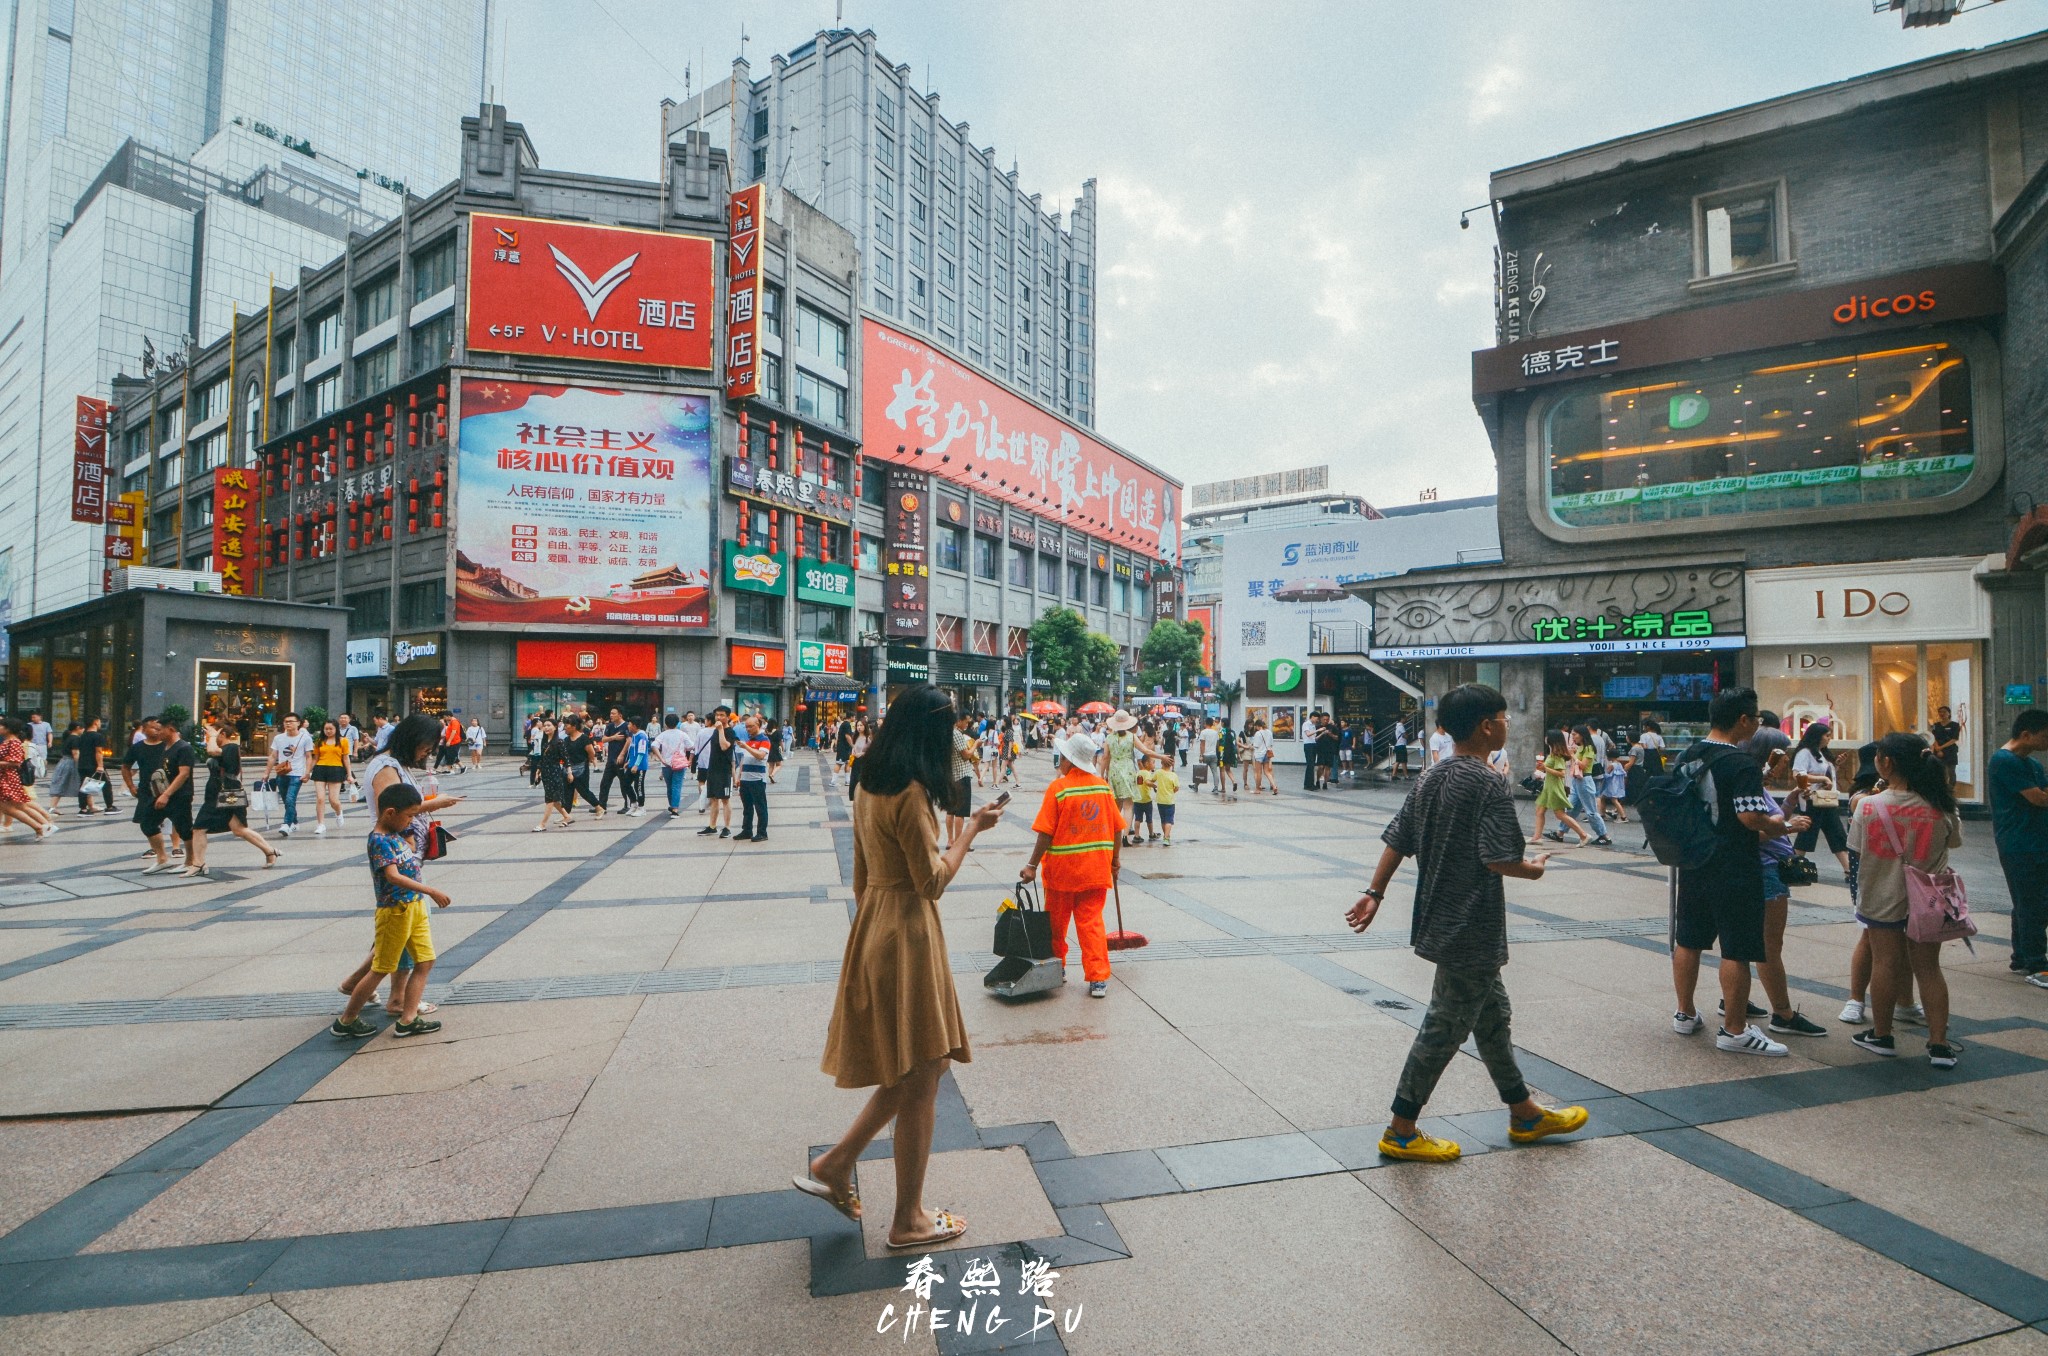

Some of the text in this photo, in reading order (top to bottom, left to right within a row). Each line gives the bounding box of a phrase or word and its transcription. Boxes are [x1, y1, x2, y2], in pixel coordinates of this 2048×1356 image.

[1507, 250, 1520, 344] ZHENG KEJIA
[1833, 290, 1936, 324] dicos
[638, 297, 696, 330] 酒店
[504, 326, 525, 338] 5F
[730, 287, 753, 368] 酒店
[887, 335, 909, 350] GREE
[1521, 339, 1619, 376] 德克士
[739, 371, 753, 385] 5F
[516, 422, 659, 453] 社会主义
[497, 448, 675, 480] 核心价值观
[76, 461, 101, 507] 酒店
[756, 468, 814, 504] 春熙里
[515, 539, 535, 549] 社会
[1305, 540, 1359, 557] 蓝润商业
[515, 552, 535, 562] 公民
[806, 569, 848, 595] 好伦哥
[1816, 590, 1825, 619] I
[1532, 610, 1713, 642] 优汁凉品
[410, 641, 437, 660] panda
[1413, 648, 1441, 657] FRUIT
[1445, 647, 1475, 655] JUICE
[1589, 639, 1711, 651] YOOJI SINCE 1999
[889, 660, 928, 671] Helen Princess
[1787, 654, 1793, 669] I
[954, 672, 989, 682] SELECTED
